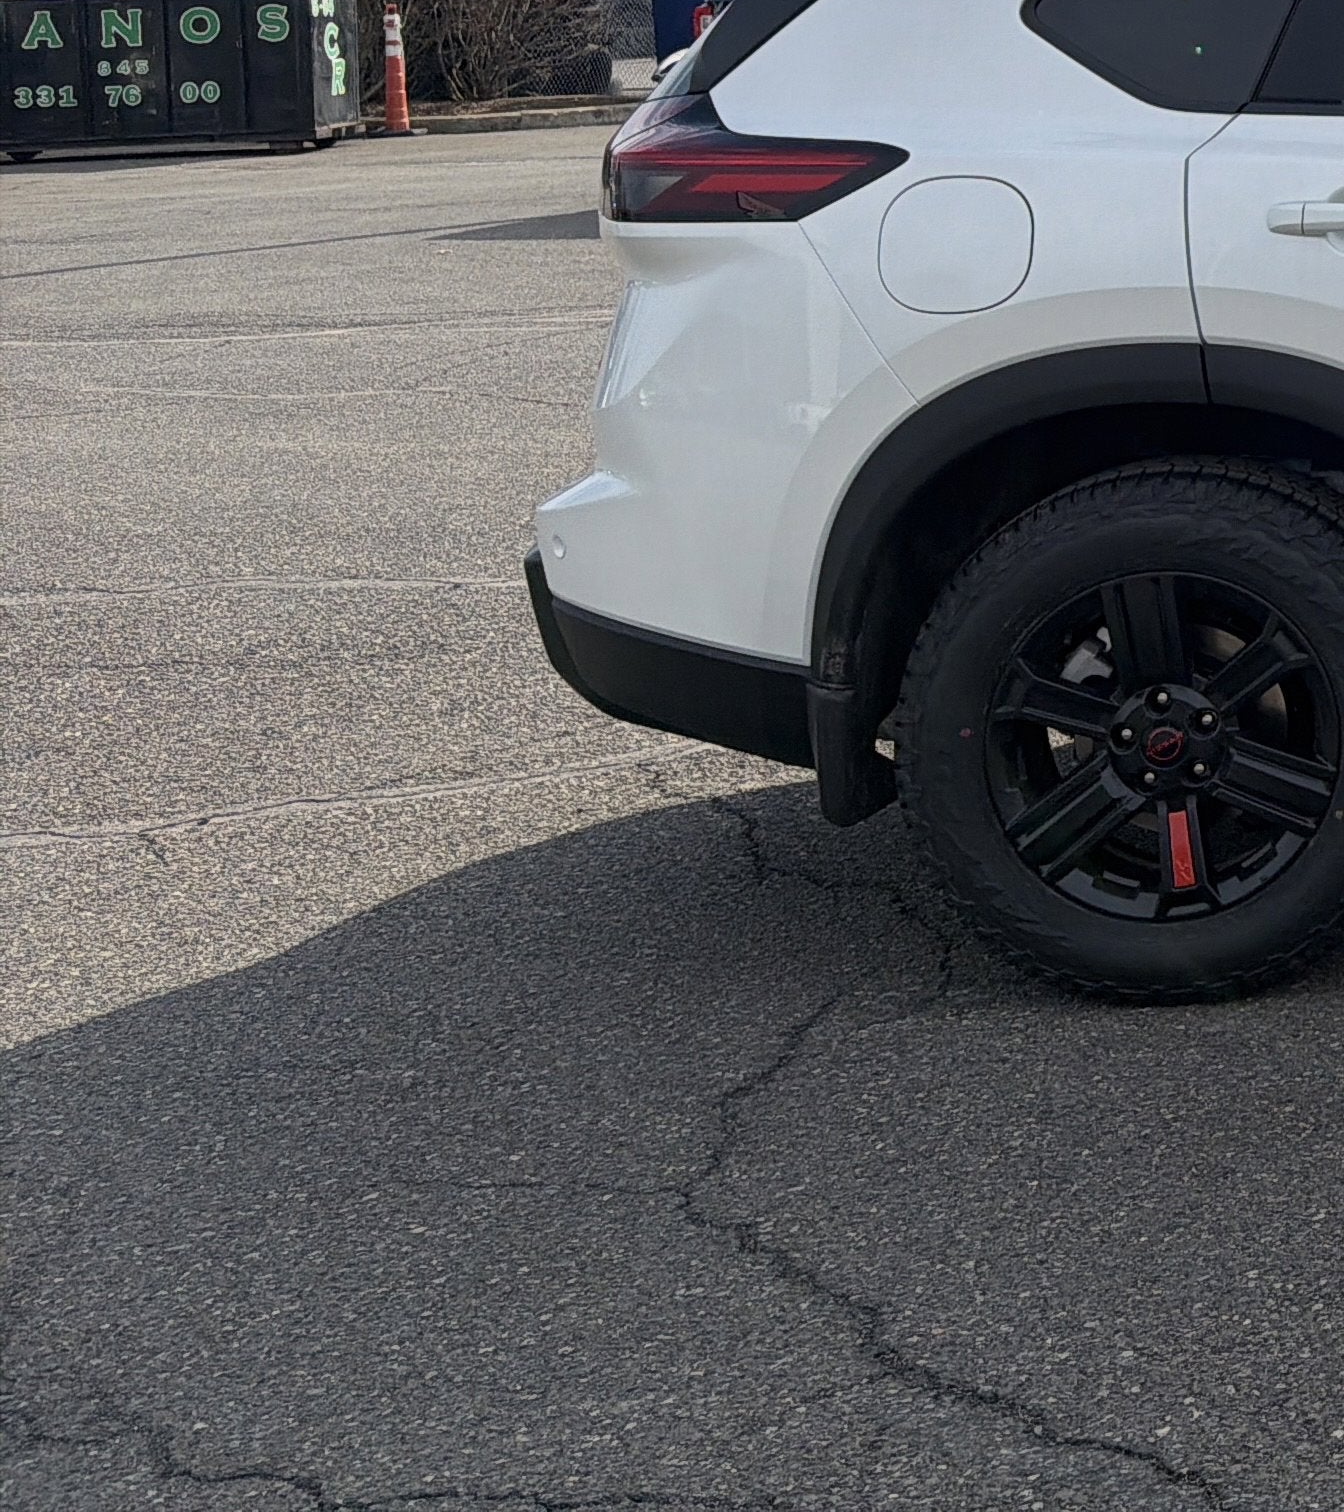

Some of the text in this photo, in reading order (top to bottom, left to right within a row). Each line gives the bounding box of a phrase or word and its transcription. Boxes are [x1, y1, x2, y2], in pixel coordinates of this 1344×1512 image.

[13, 80, 221, 109] 331 76 00
